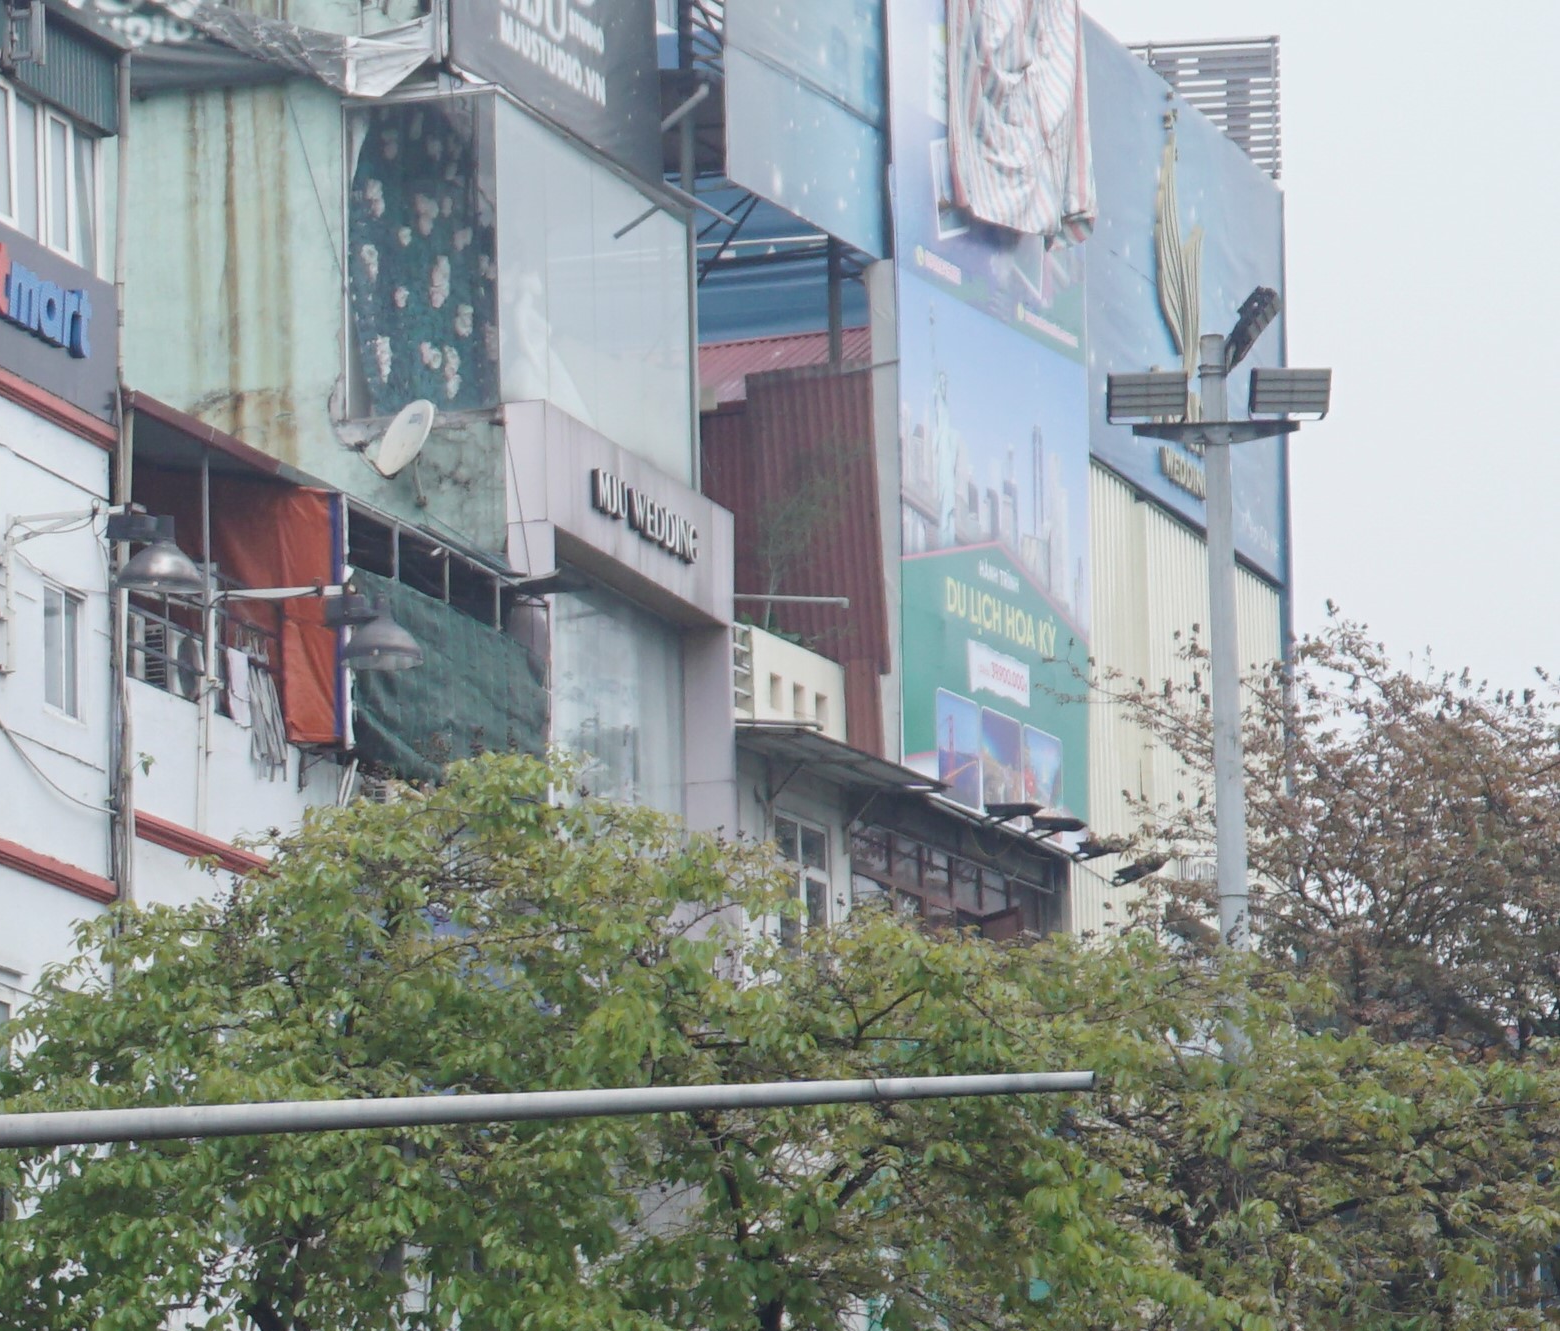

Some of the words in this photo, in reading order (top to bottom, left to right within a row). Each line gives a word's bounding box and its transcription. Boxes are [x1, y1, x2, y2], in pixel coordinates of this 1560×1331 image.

[499, 10, 607, 107] MJUSTUDIO.VN
[591, 468, 629, 520] MJU
[627, 487, 700, 564] WEDDING
[946, 575, 967, 619] DU
[970, 586, 1003, 636] LỊCH
[1005, 603, 1037, 651] HOA
